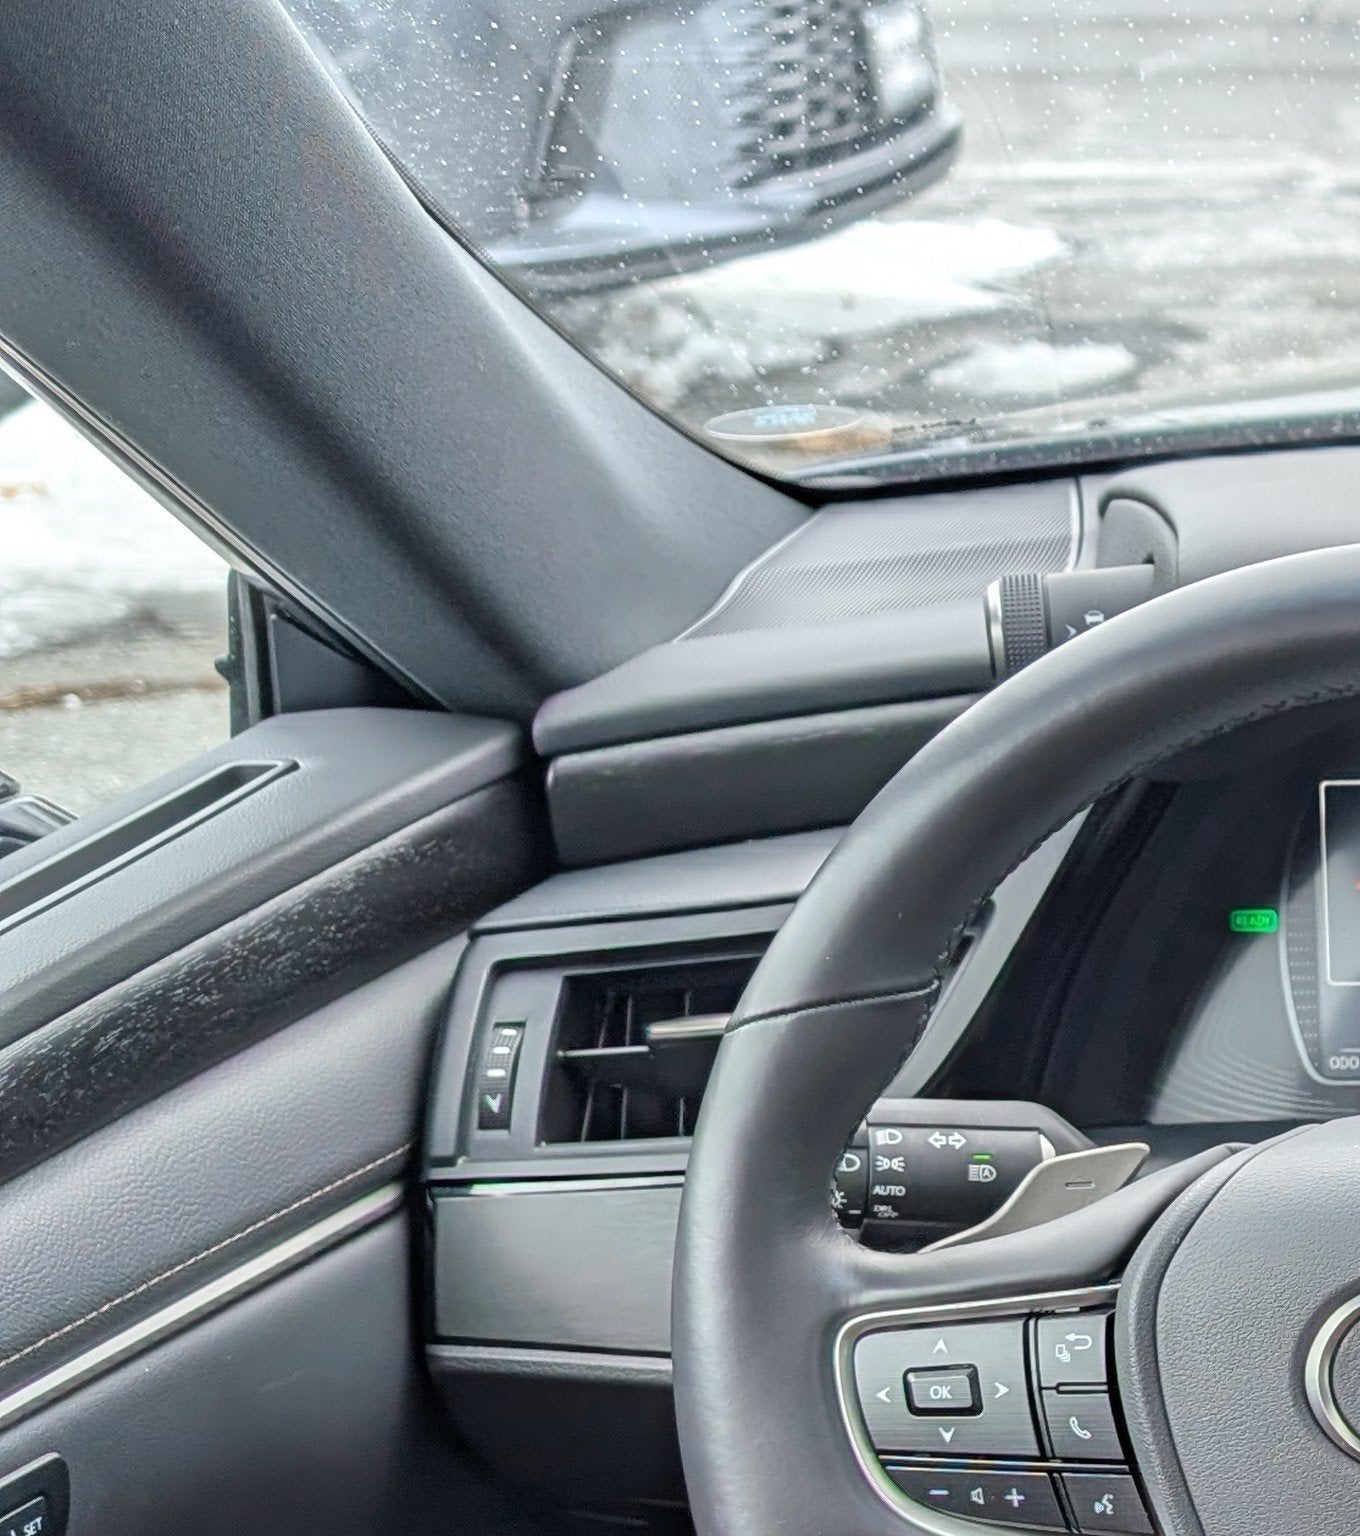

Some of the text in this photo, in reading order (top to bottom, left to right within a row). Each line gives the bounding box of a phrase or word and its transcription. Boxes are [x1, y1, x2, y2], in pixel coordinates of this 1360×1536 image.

[1329, 1055, 1360, 1070] ODO
[872, 1184, 907, 1197] AUTO
[929, 1385, 952, 1400] OK
